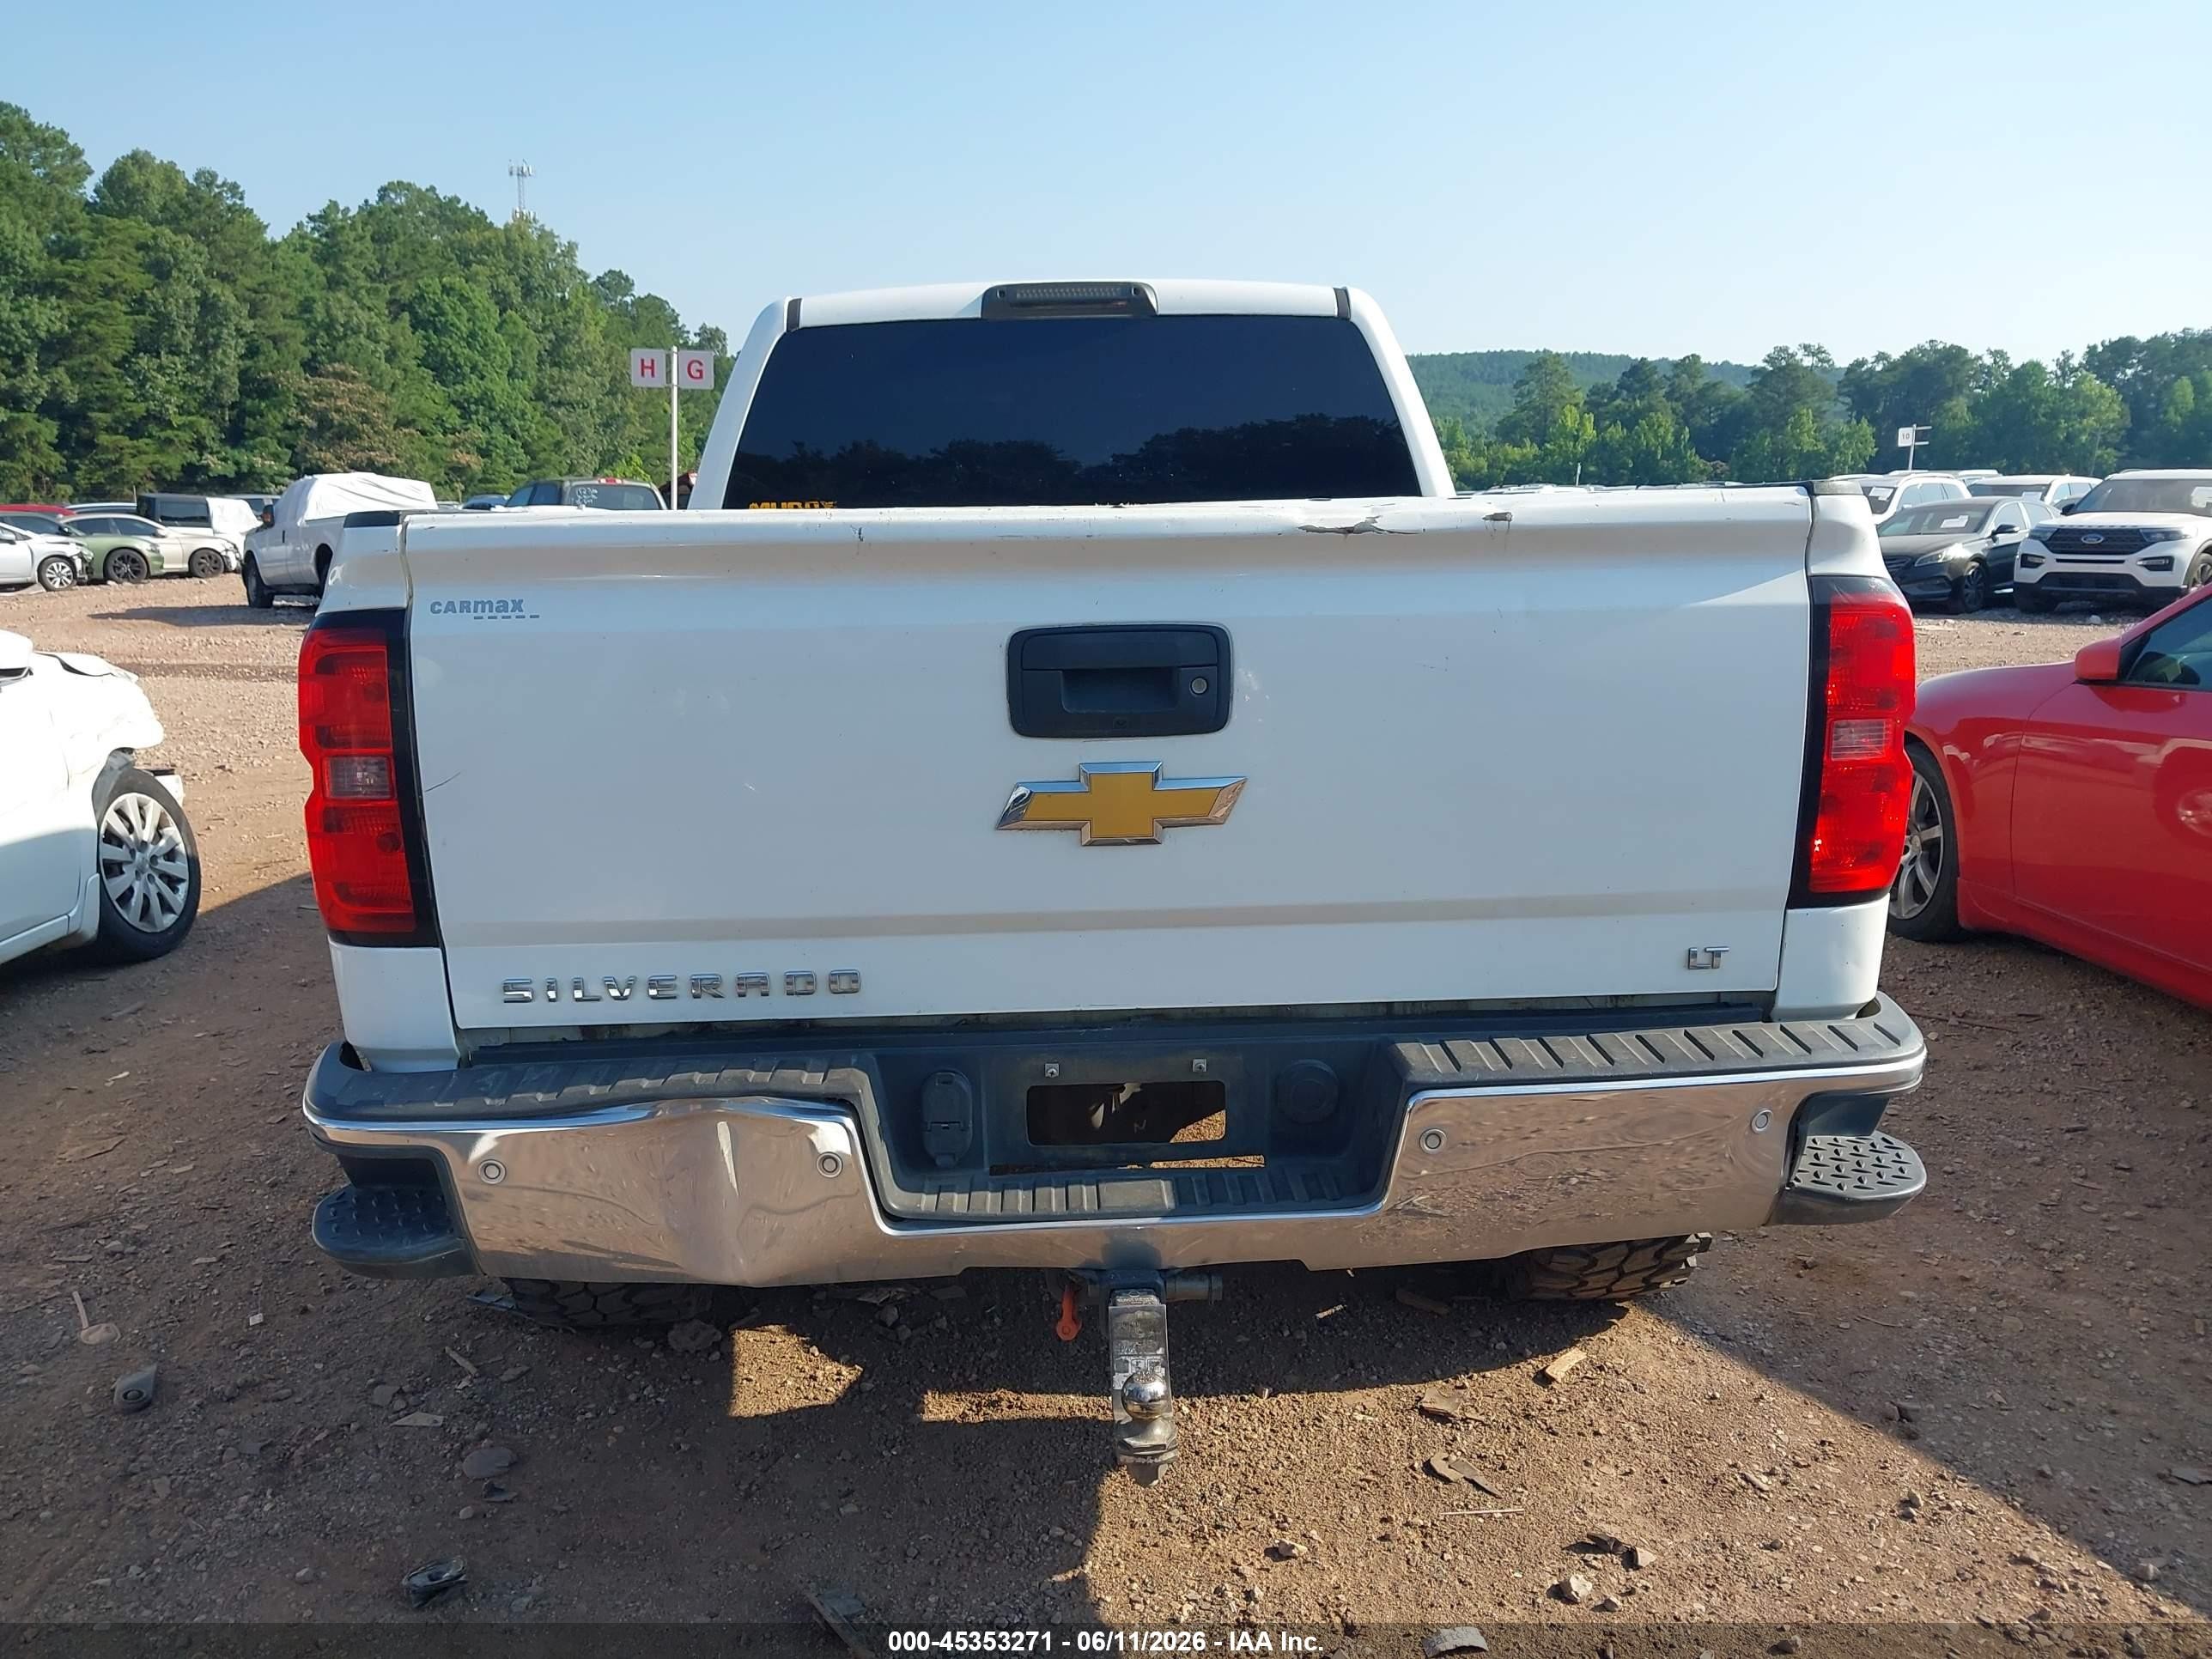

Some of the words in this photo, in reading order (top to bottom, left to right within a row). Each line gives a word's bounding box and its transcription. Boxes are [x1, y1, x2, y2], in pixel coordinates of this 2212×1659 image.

[640, 357, 655, 379] H
[686, 359, 705, 380] G
[1687, 946, 1730, 970] LT
[502, 968, 861, 1004] SILVERADO
